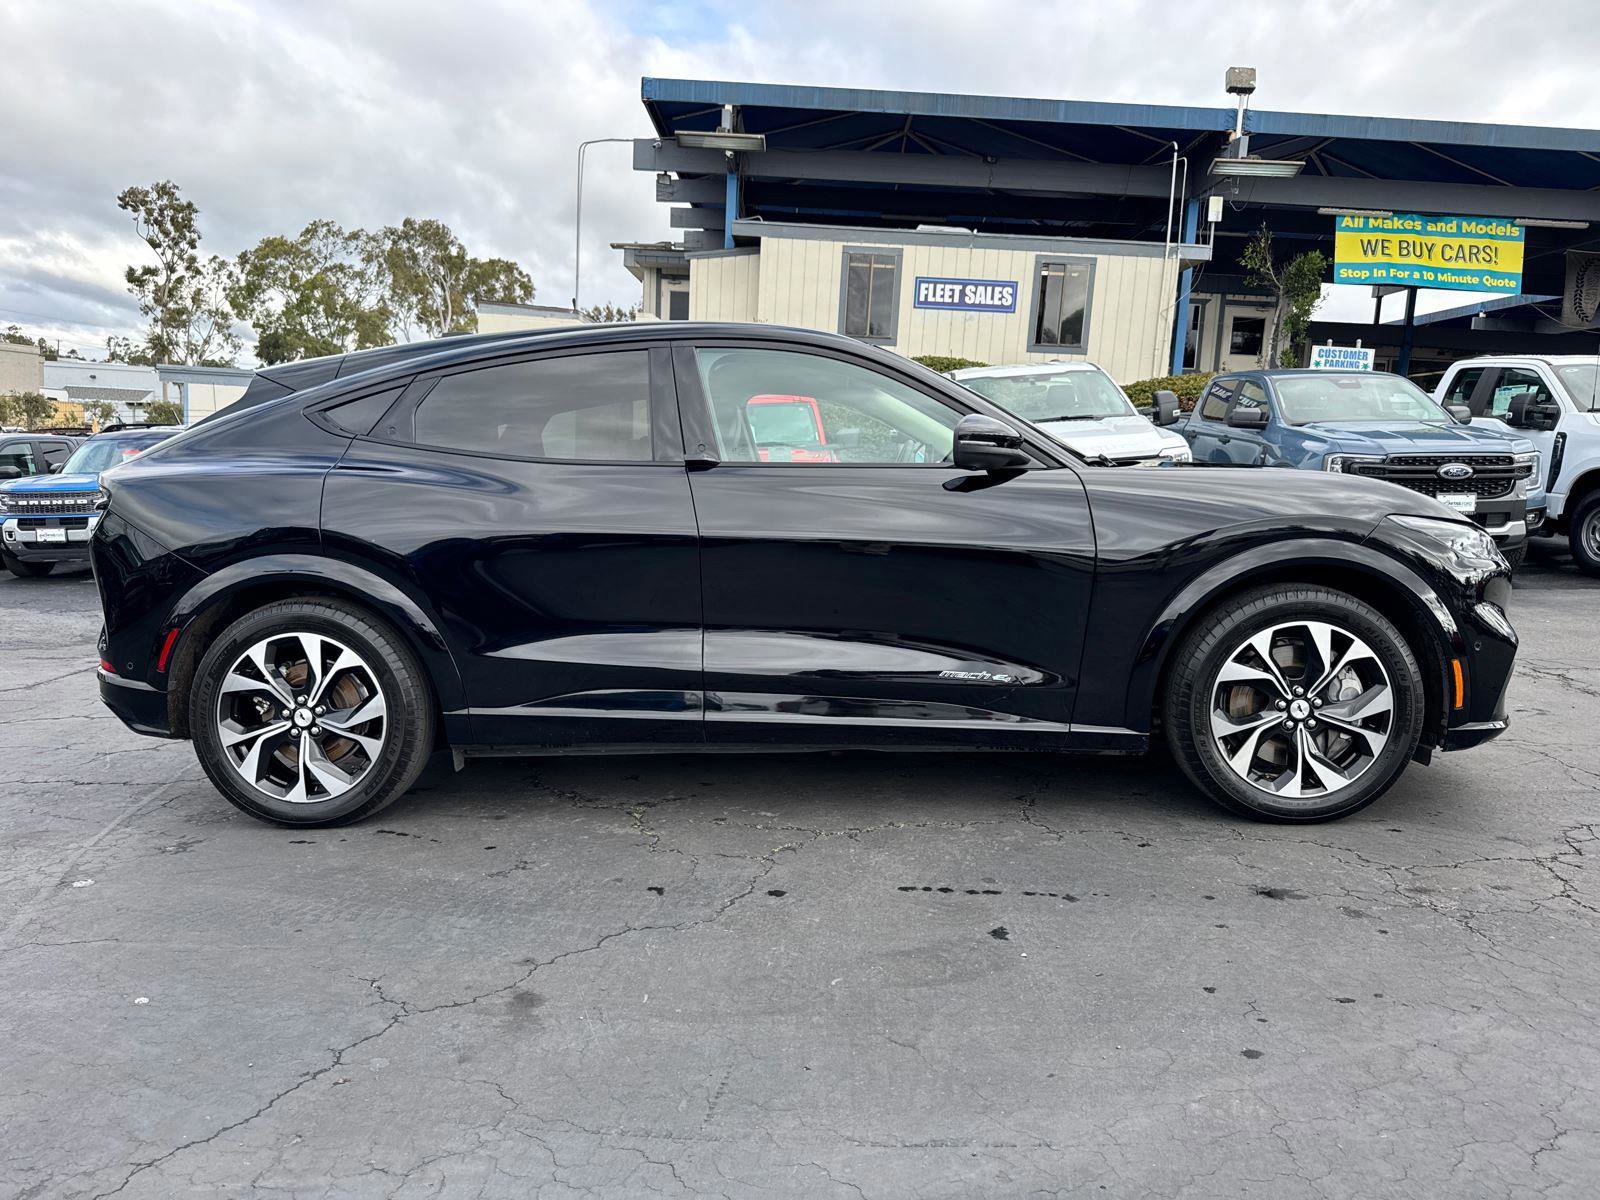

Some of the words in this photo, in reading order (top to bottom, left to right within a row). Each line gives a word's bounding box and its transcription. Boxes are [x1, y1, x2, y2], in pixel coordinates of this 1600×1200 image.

[1341, 215, 1363, 228] All
[1369, 217, 1422, 231] Makes
[1426, 221, 1457, 233] and
[1462, 221, 1519, 237] Models
[1360, 239, 1393, 257] WE
[1399, 240, 1436, 261] BUY
[1441, 244, 1499, 265] CARS!
[1340, 268, 1370, 279] Stop
[1374, 269, 1387, 278] In
[1390, 269, 1410, 278] For
[1413, 271, 1420, 279] a
[1423, 271, 1434, 280] 10
[1438, 272, 1479, 284] Minute
[1483, 275, 1516, 287] Quote
[919, 282, 962, 303] FLEET
[965, 284, 1013, 306] SALES
[1318, 348, 1368, 361] CUSTOMER
[1324, 359, 1360, 369] PARKING
